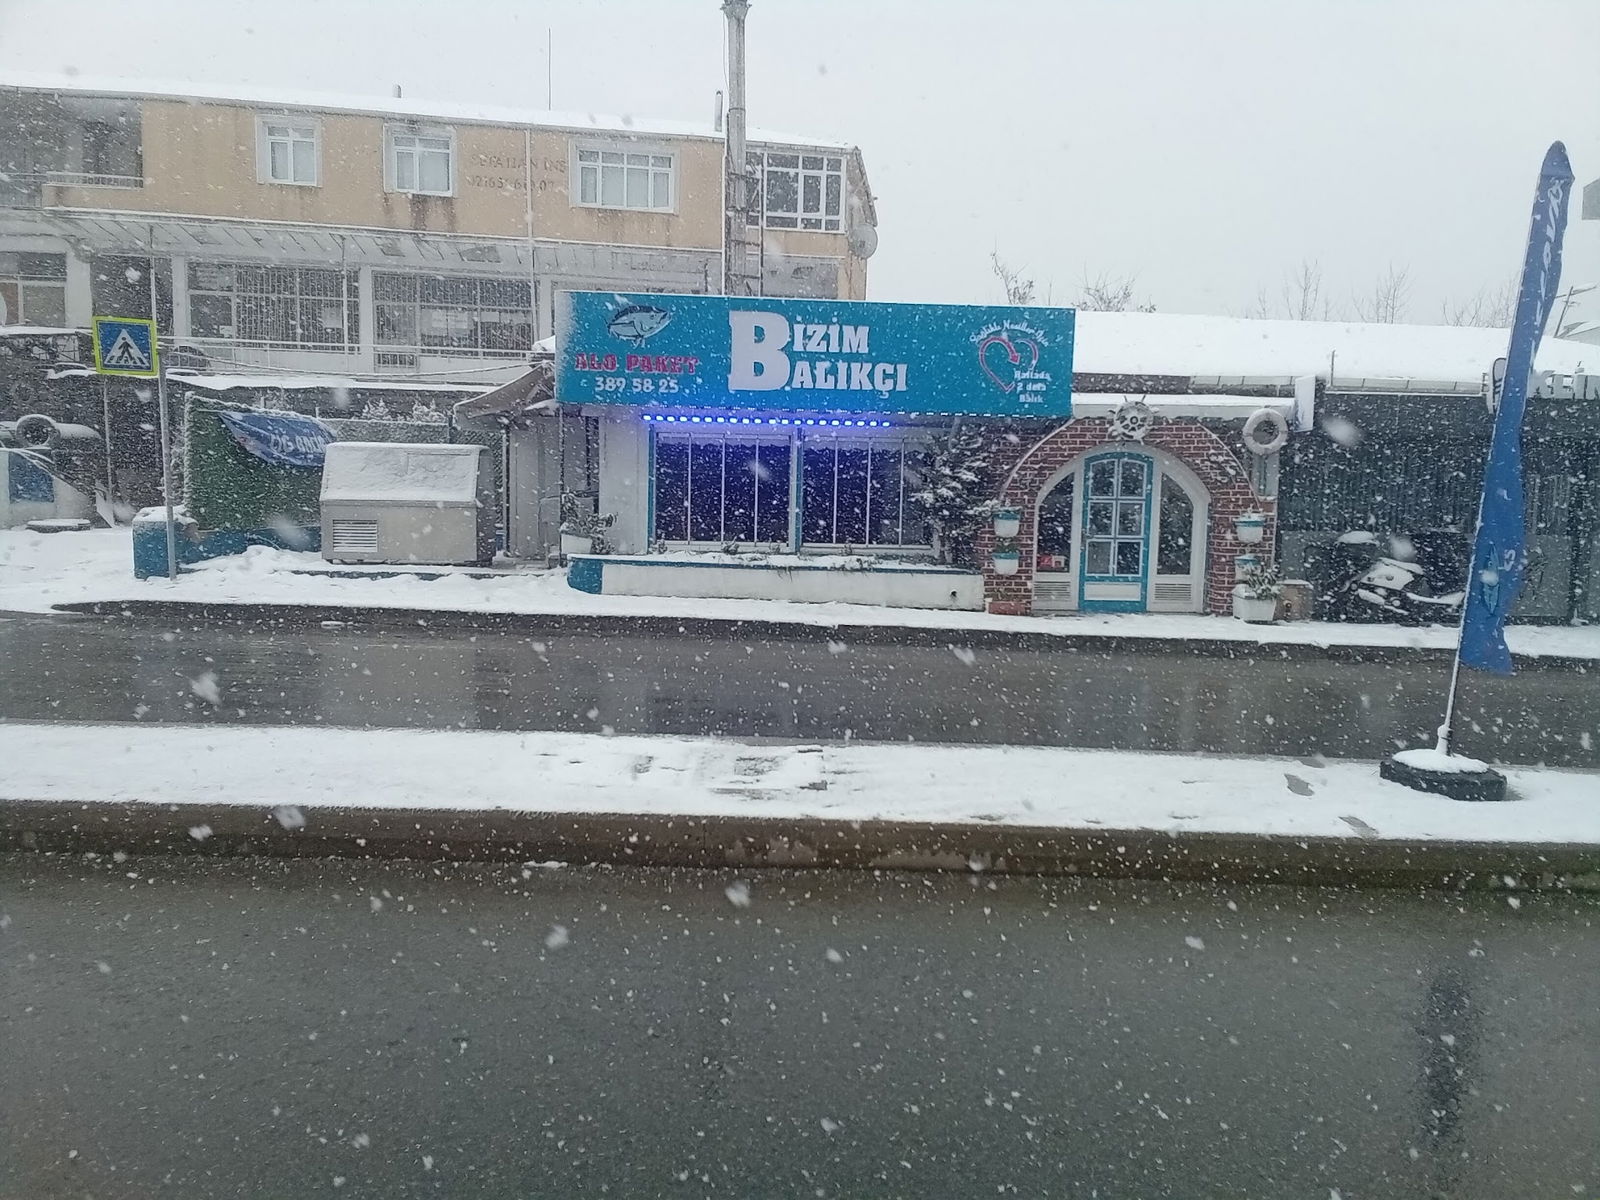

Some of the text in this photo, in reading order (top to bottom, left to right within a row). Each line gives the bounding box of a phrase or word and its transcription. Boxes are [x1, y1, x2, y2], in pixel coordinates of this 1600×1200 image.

[728, 310, 870, 391] BİZİM
[575, 353, 699, 375] ALO PAKET
[594, 376, 679, 393] 389 58 25
[1016, 382, 1024, 392] 2
